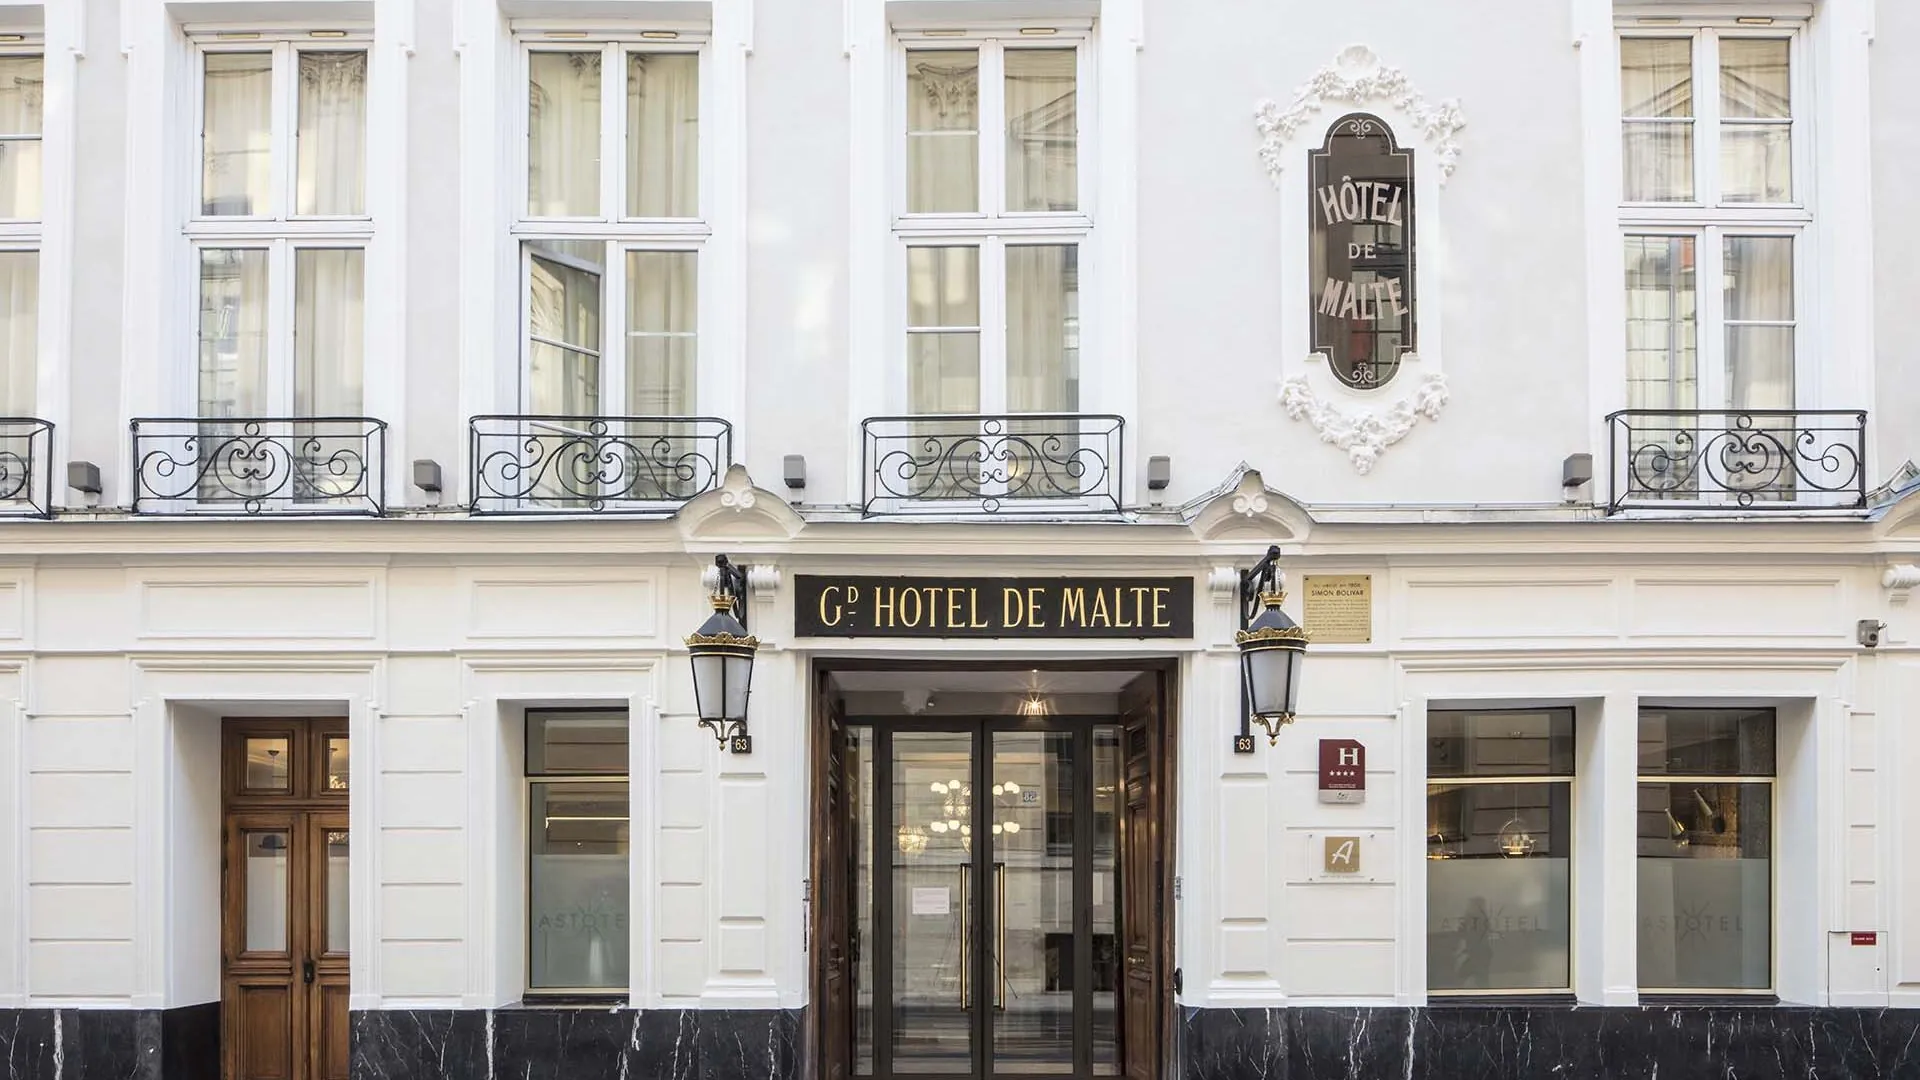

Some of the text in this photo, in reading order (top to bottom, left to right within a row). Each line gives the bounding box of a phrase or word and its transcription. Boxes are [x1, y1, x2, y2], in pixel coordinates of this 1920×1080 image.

[1317, 175, 1403, 227] HÔTEL
[1347, 243, 1377, 260] DE
[1318, 277, 1408, 320] MALTE
[874, 587, 988, 628] HOTEL
[1002, 587, 1046, 628] DE
[1060, 587, 1171, 628] MALTE
[735, 738, 747, 750] 63
[1239, 738, 1250, 750] 63
[1338, 747, 1360, 766] H
[1331, 840, 1354, 865] A
